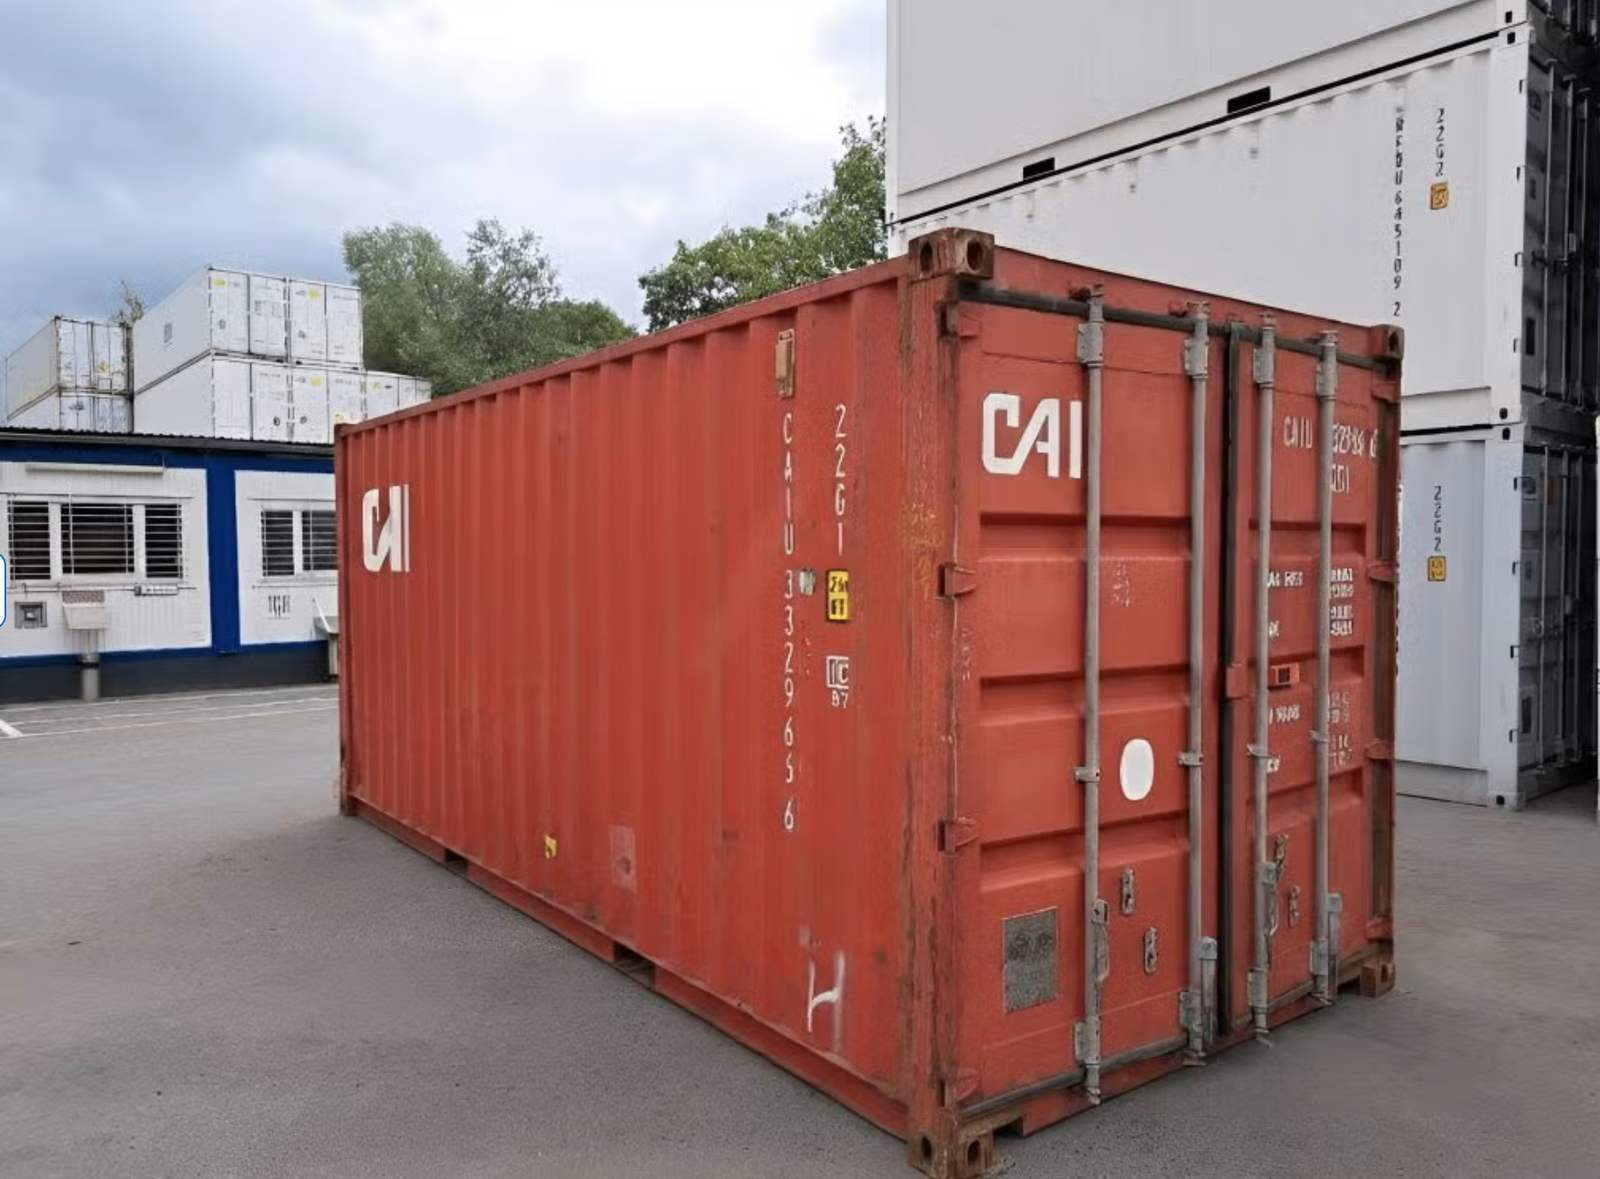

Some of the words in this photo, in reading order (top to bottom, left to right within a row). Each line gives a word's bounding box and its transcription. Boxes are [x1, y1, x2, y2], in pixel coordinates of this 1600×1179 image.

[783, 412, 795, 556] CAIU
[834, 403, 848, 557] 22G1
[981, 391, 1082, 479] CAI
